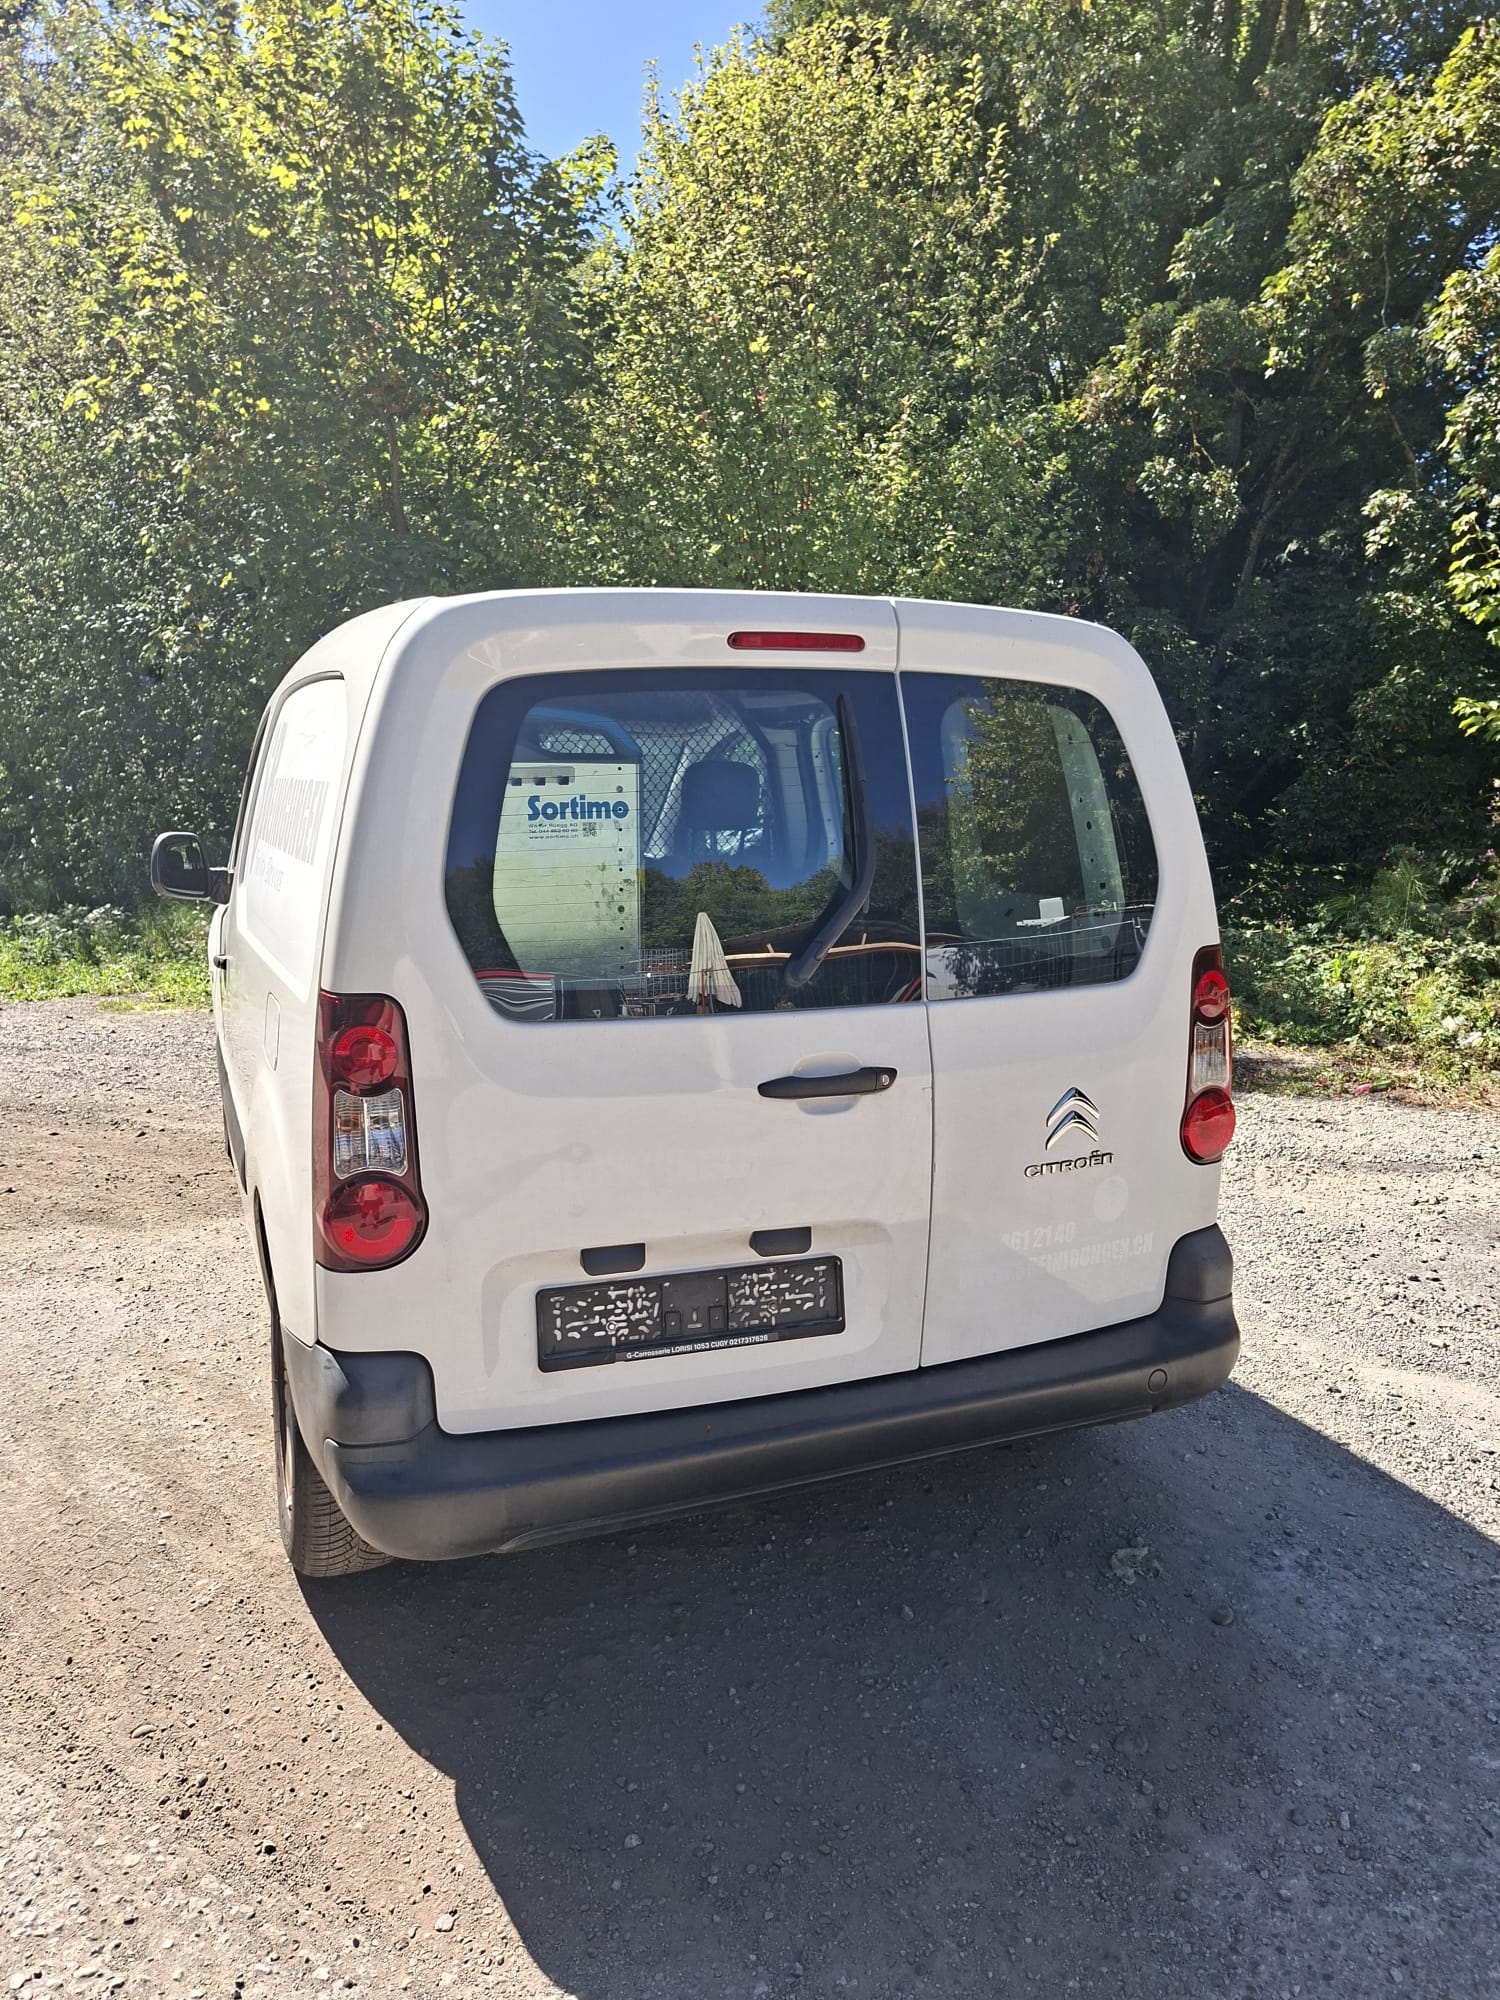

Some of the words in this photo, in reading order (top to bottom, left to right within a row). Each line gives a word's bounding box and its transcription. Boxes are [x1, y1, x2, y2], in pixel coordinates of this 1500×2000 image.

[527, 794, 630, 821] Sortimo
[626, 1347, 671, 1359] G-Carrosserie
[671, 1343, 693, 1354] LORISI
[694, 1340, 710, 1351] 1053
[710, 1339, 729, 1349] CUGY
